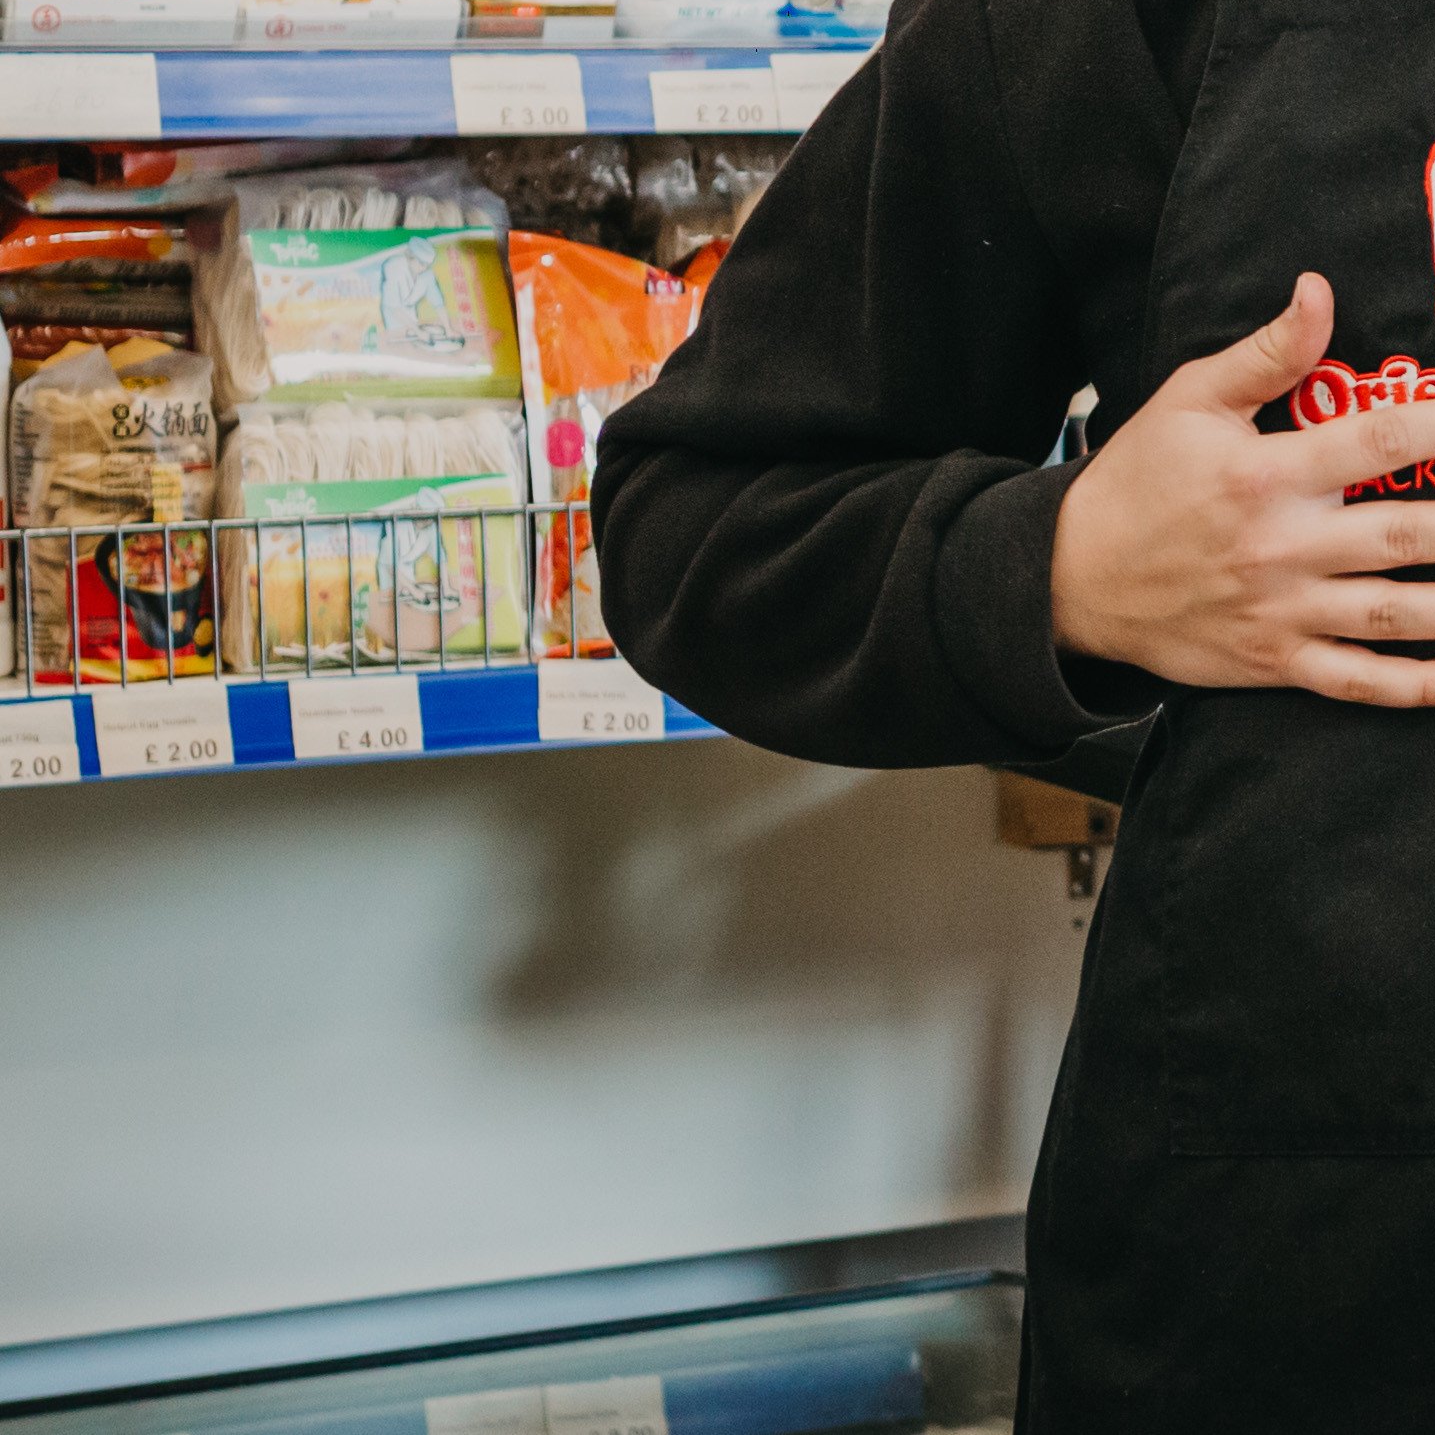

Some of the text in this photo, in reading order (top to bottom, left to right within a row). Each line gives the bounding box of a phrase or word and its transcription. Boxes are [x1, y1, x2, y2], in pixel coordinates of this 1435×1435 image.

[522, 106, 570, 126] 3.00
[718, 105, 763, 124] 2.00
[134, 402, 209, 437] 火锅面
[583, 712, 649, 732] £ 2.00
[338, 727, 408, 751] £ 4.00
[145, 739, 217, 765] £ 2.00
[10, 756, 62, 779] 2.00
